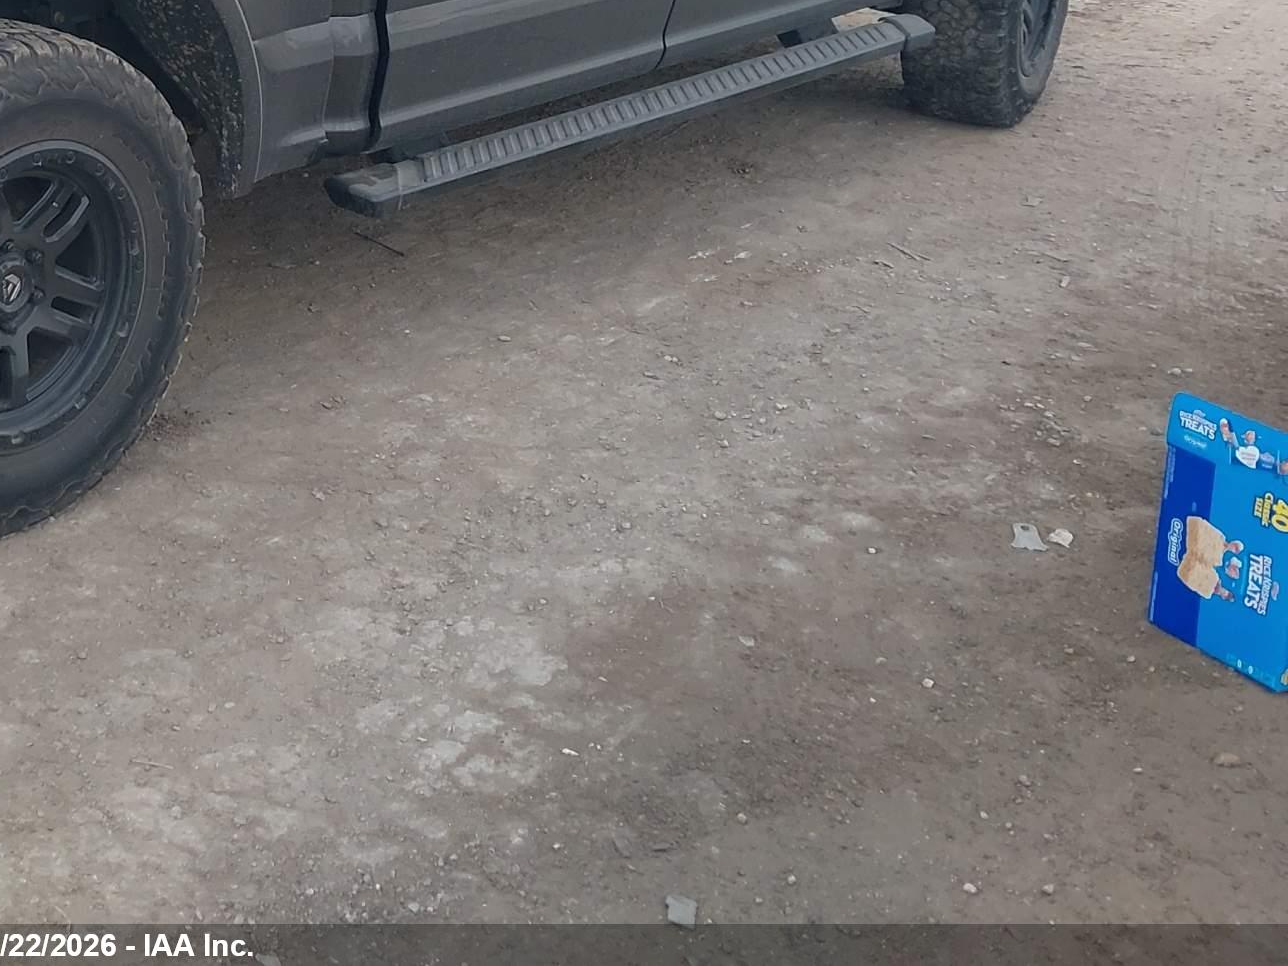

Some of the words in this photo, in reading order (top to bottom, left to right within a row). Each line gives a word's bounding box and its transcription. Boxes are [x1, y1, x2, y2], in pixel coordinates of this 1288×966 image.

[1180, 418, 1215, 440] TREATS
[1169, 519, 1182, 565] Original
[1244, 554, 1263, 609] TREATS
[1262, 555, 1272, 575] RICE
[1257, 577, 1272, 615] KRISPIES
